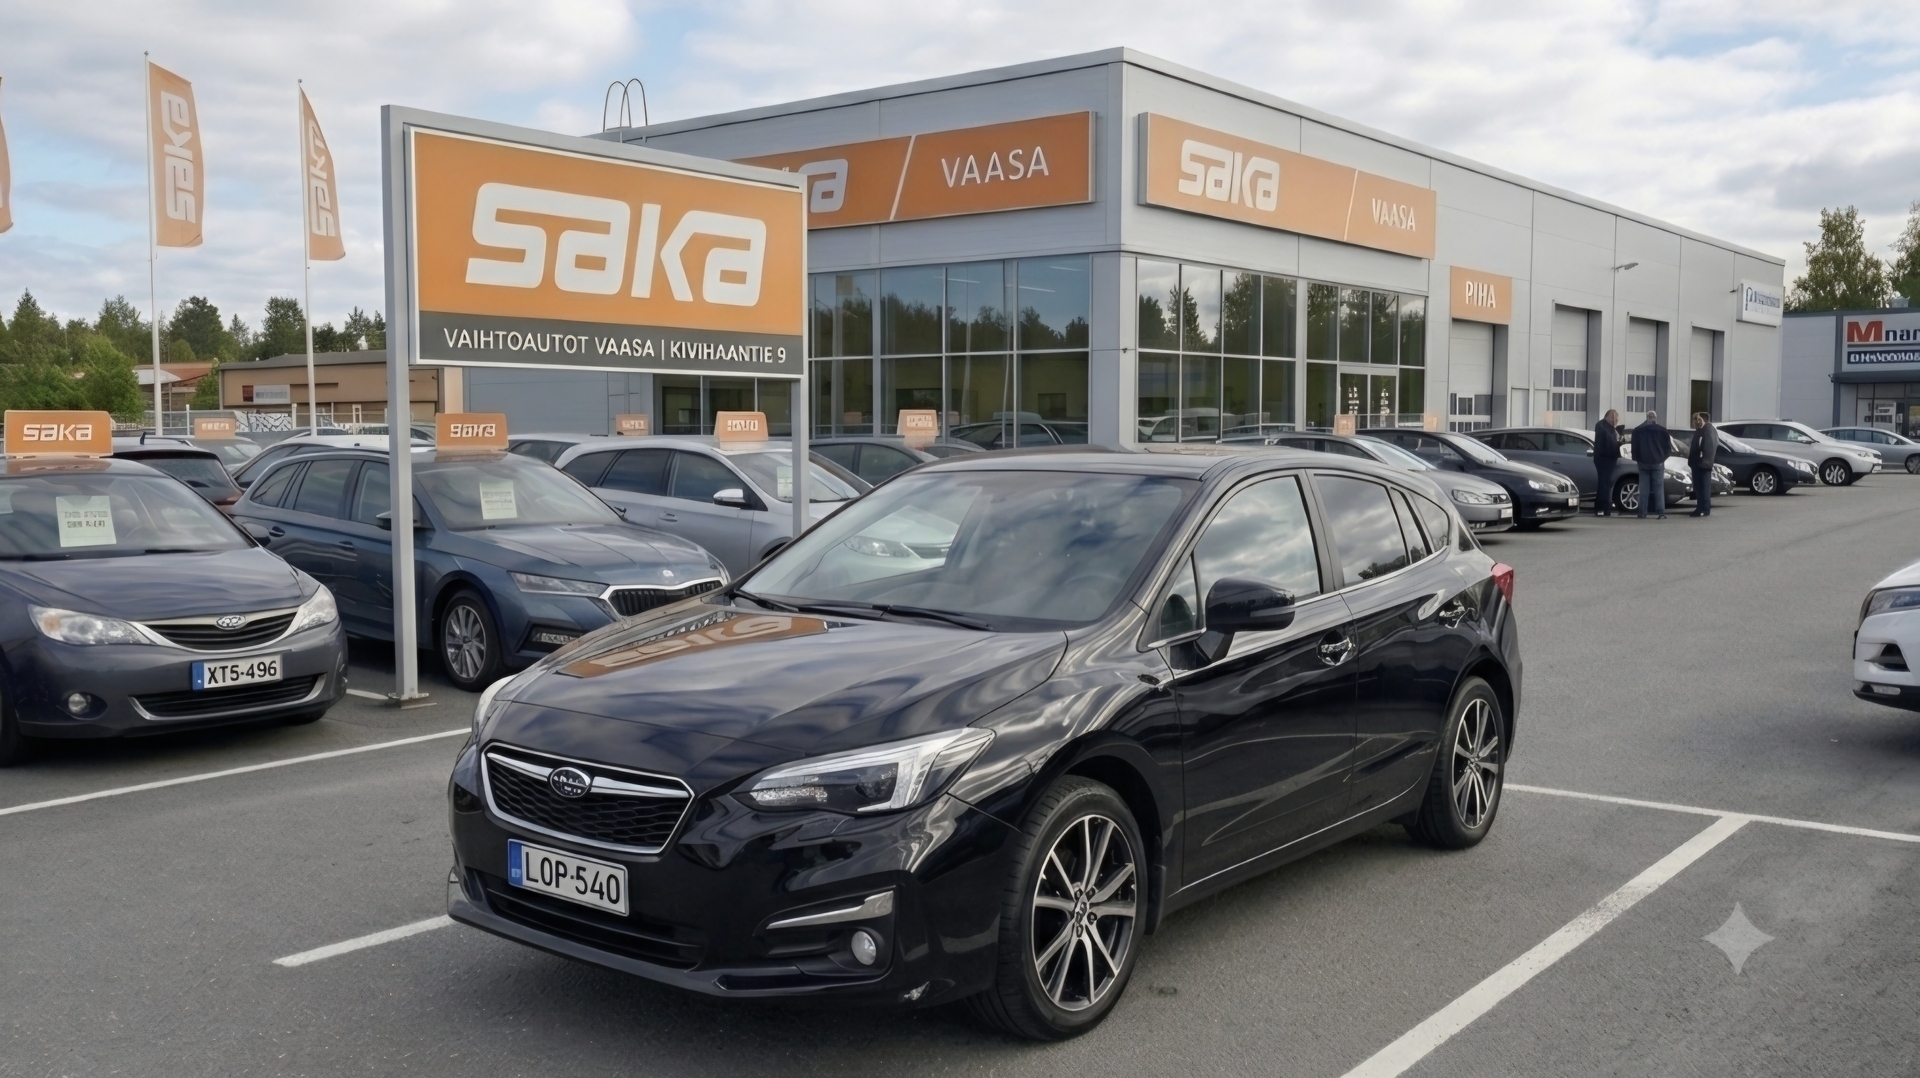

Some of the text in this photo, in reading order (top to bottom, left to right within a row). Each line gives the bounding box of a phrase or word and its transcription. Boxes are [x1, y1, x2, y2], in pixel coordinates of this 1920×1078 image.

[941, 146, 1050, 188] VAASA
[1372, 197, 1416, 232] VAASA
[1465, 280, 1496, 309] PIHA
[443, 327, 589, 354] VAIHTOAUTOT
[594, 336, 655, 357] VAASA
[670, 340, 773, 363] KIVIHAANTIE
[777, 347, 786, 364] 9
[207, 660, 277, 685] XT5-496
[524, 851, 621, 905] LOP-540
